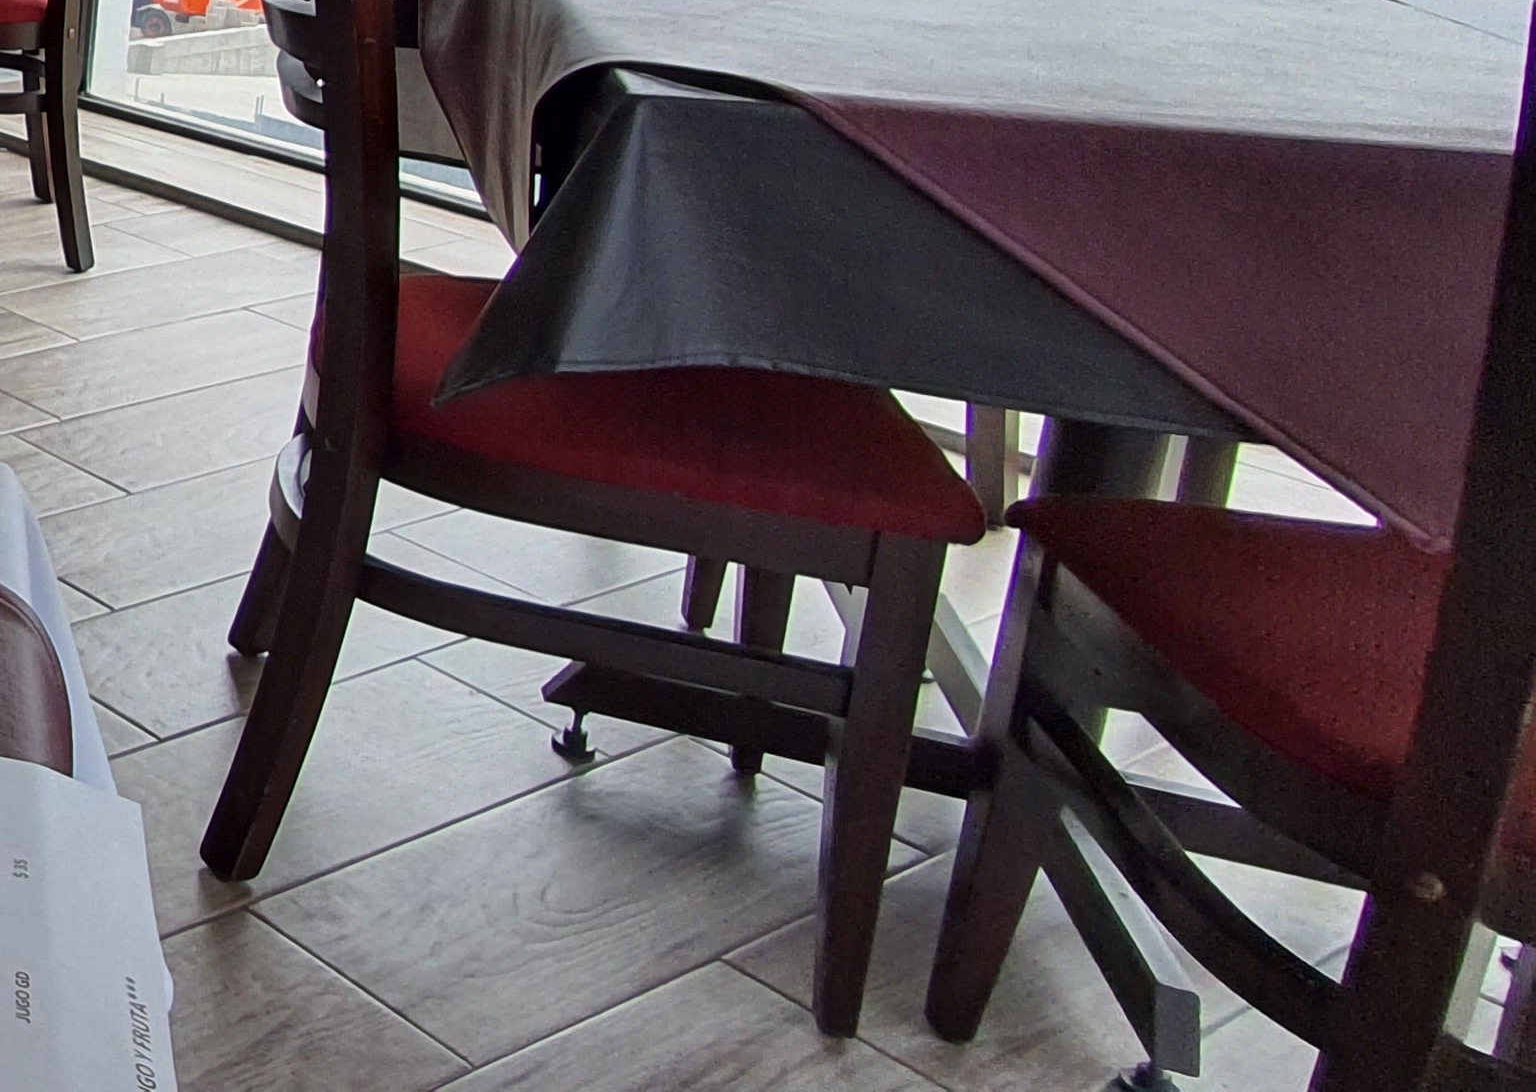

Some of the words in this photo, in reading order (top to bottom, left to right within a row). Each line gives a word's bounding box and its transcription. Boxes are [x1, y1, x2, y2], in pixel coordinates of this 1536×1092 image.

[15, 971, 31, 989] GD
[15, 990, 31, 1024] JUGO
[133, 1048, 153, 1063] Y
